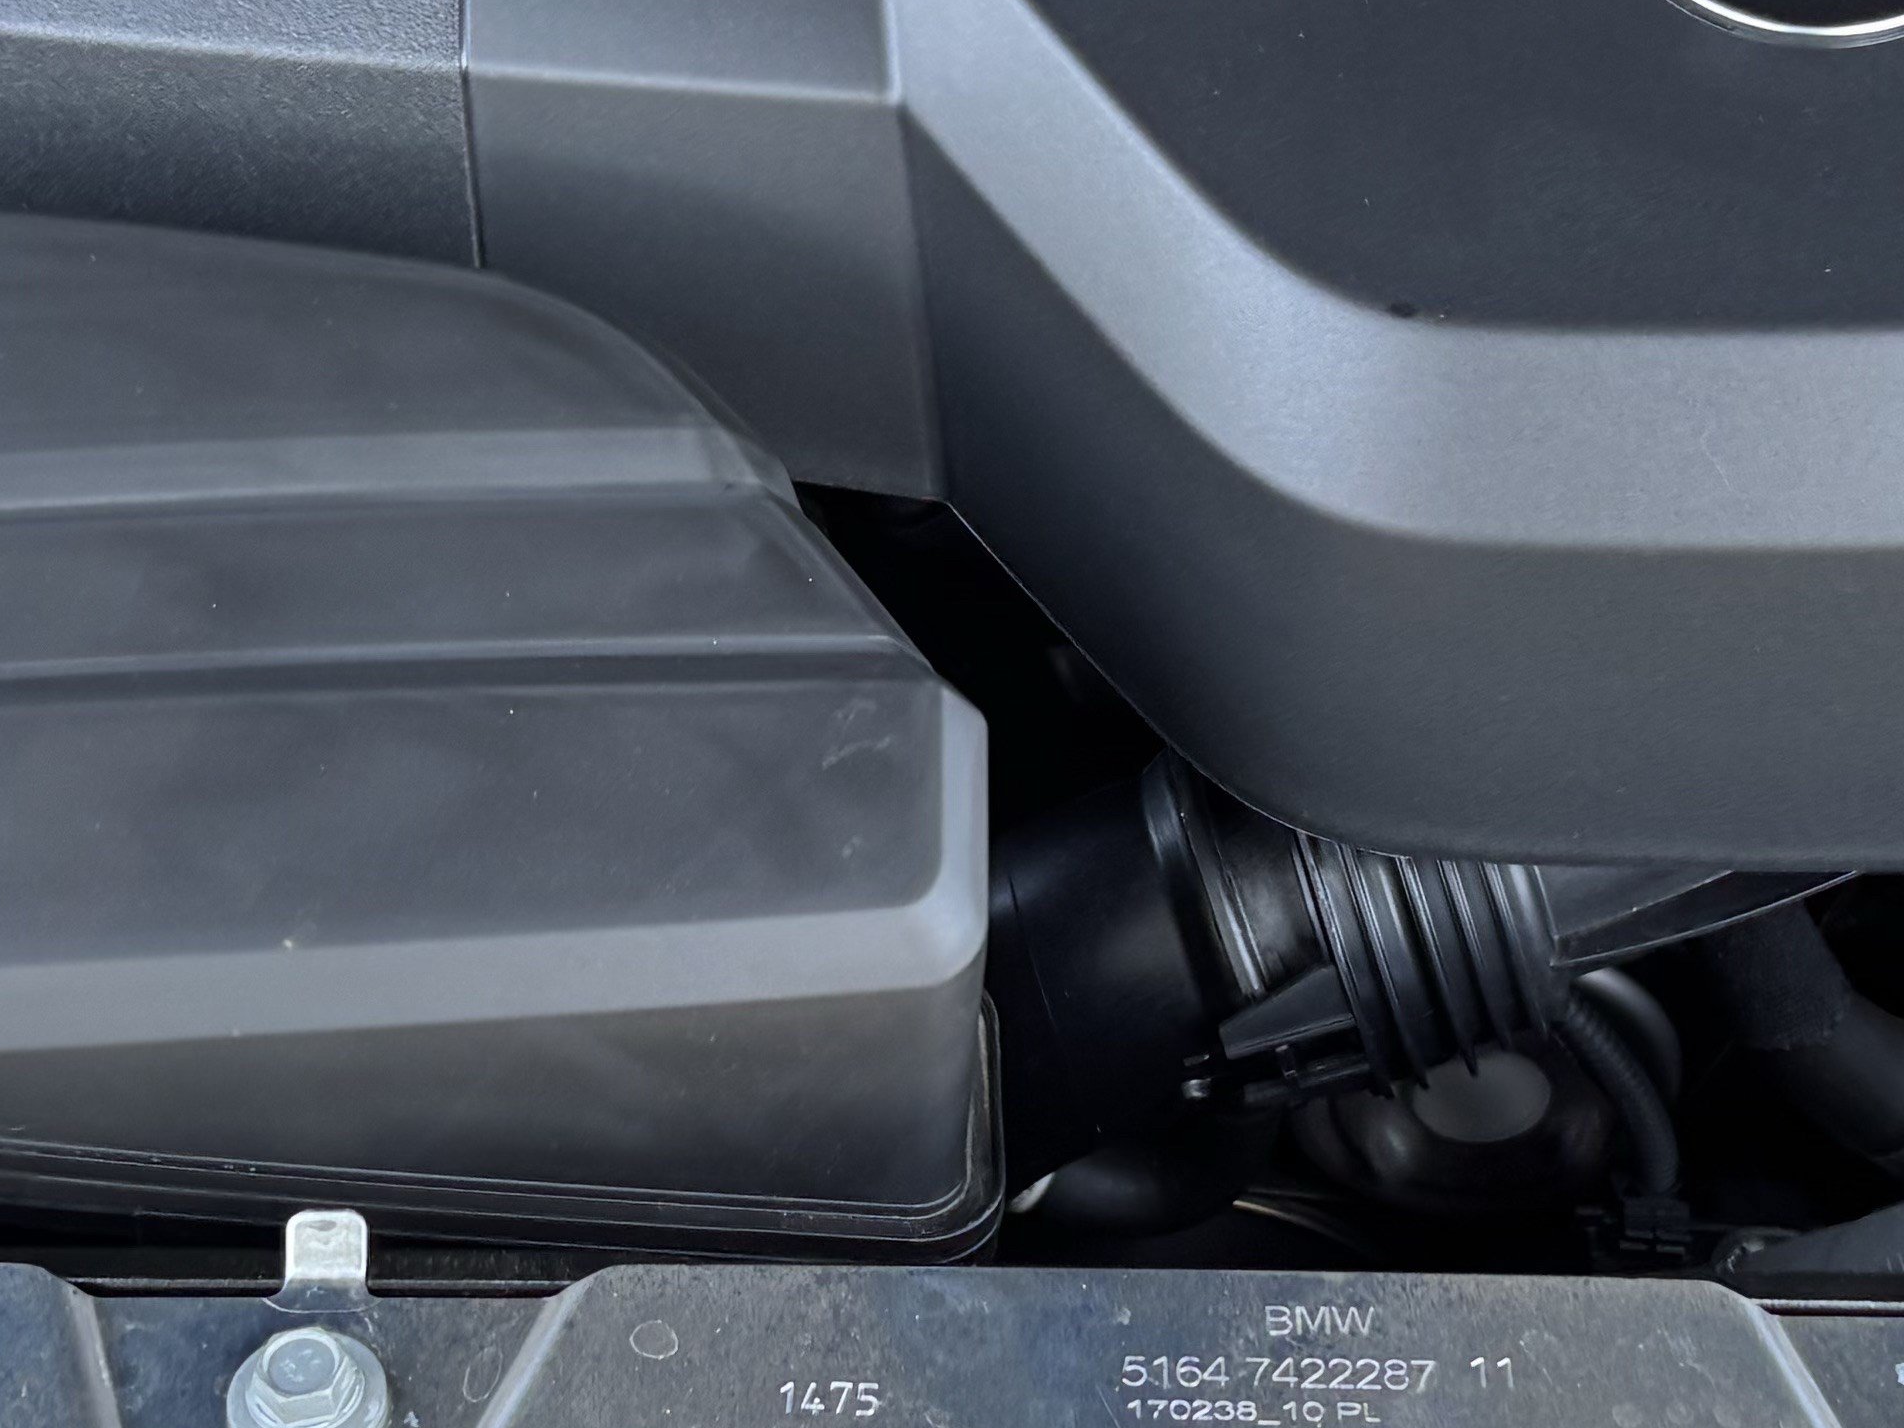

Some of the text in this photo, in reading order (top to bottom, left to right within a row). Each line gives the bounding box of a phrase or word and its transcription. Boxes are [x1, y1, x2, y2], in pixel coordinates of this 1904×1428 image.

[1264, 1305, 1374, 1336] BMW
[1121, 1356, 1514, 1392] 5164 7422287 11
[780, 1380, 880, 1416] 1475
[1127, 1399, 1381, 1426] 170238_10 PL
